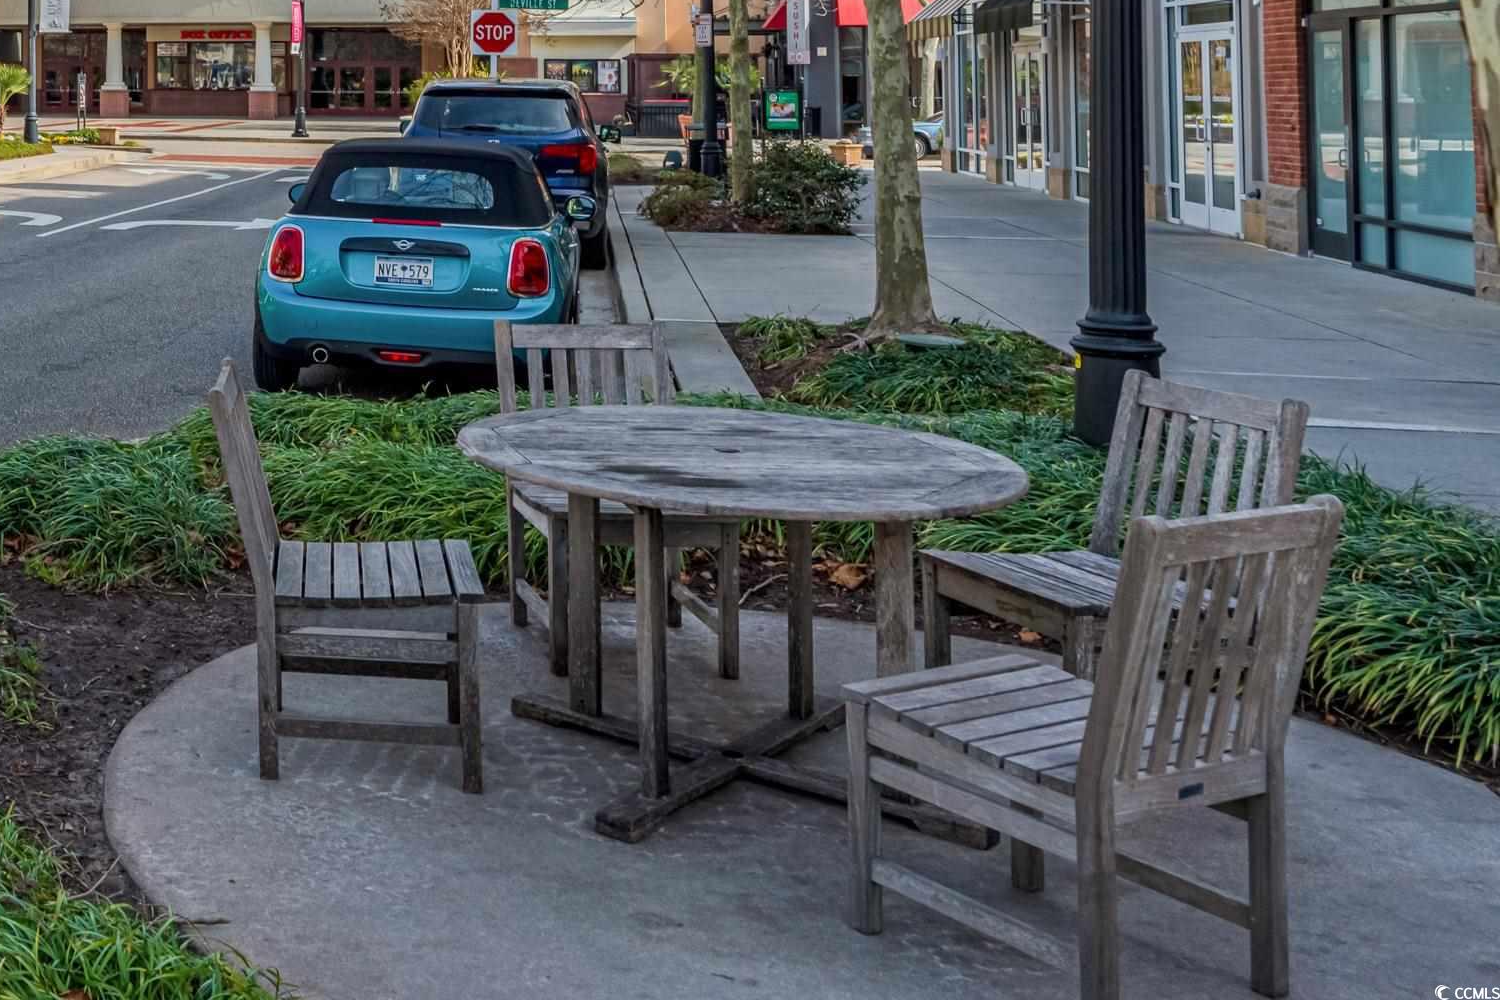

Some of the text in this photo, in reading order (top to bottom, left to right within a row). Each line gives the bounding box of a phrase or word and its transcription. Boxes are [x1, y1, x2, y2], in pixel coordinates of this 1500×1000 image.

[510, 0, 556, 9] DEVILLE ST
[180, 30, 253, 40] BOX OFFICE
[475, 24, 513, 40] STOP
[378, 263, 429, 278] NVE 579
